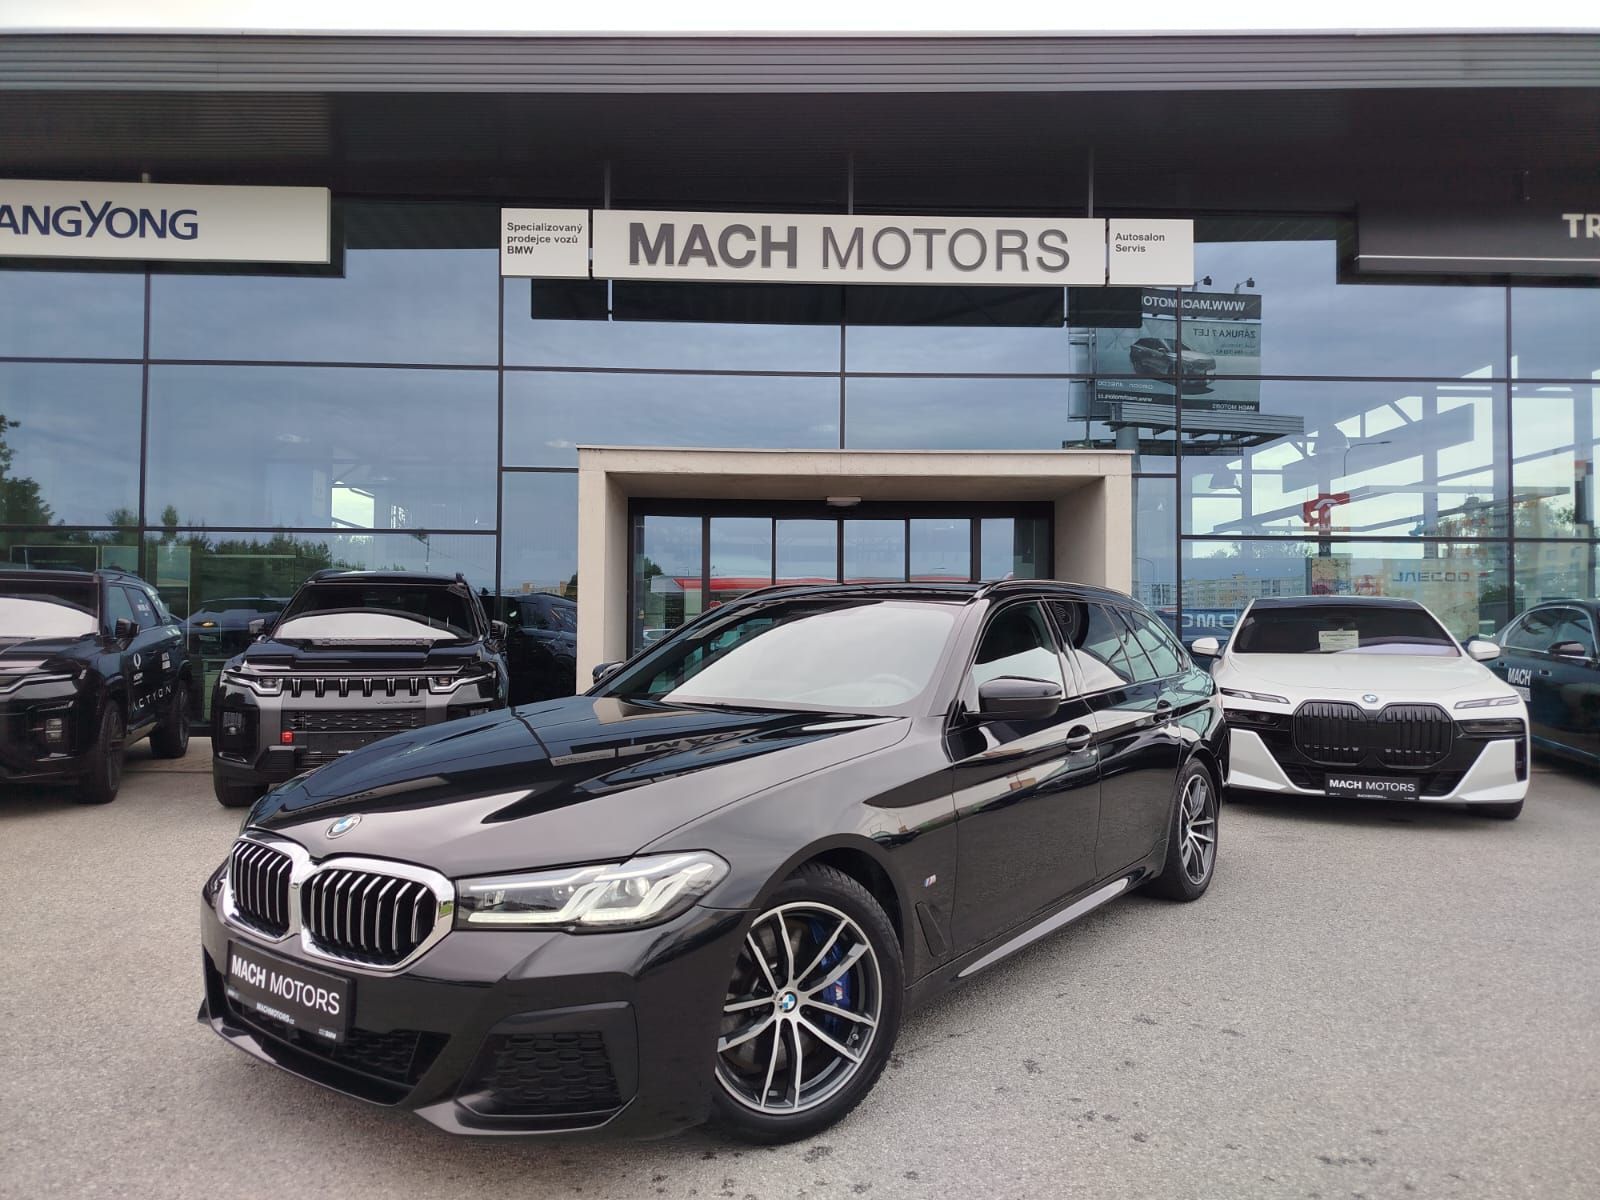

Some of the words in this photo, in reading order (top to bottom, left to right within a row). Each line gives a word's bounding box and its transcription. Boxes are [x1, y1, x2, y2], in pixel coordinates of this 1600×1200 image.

[507, 222, 583, 233] Specializovaný
[507, 235, 551, 245] prodejce
[554, 235, 578, 244] vozů
[1115, 233, 1165, 241] Autosalon
[507, 245, 534, 254] BMW
[629, 222, 797, 269] MACH
[822, 226, 1070, 272] MOTORS
[1115, 244, 1146, 252] Servis
[1508, 667, 1531, 686] MACH
[1329, 779, 1362, 789] MACH
[1366, 782, 1416, 792] MOTORS
[231, 954, 266, 989] MACH
[269, 971, 340, 1015] MOTORS
